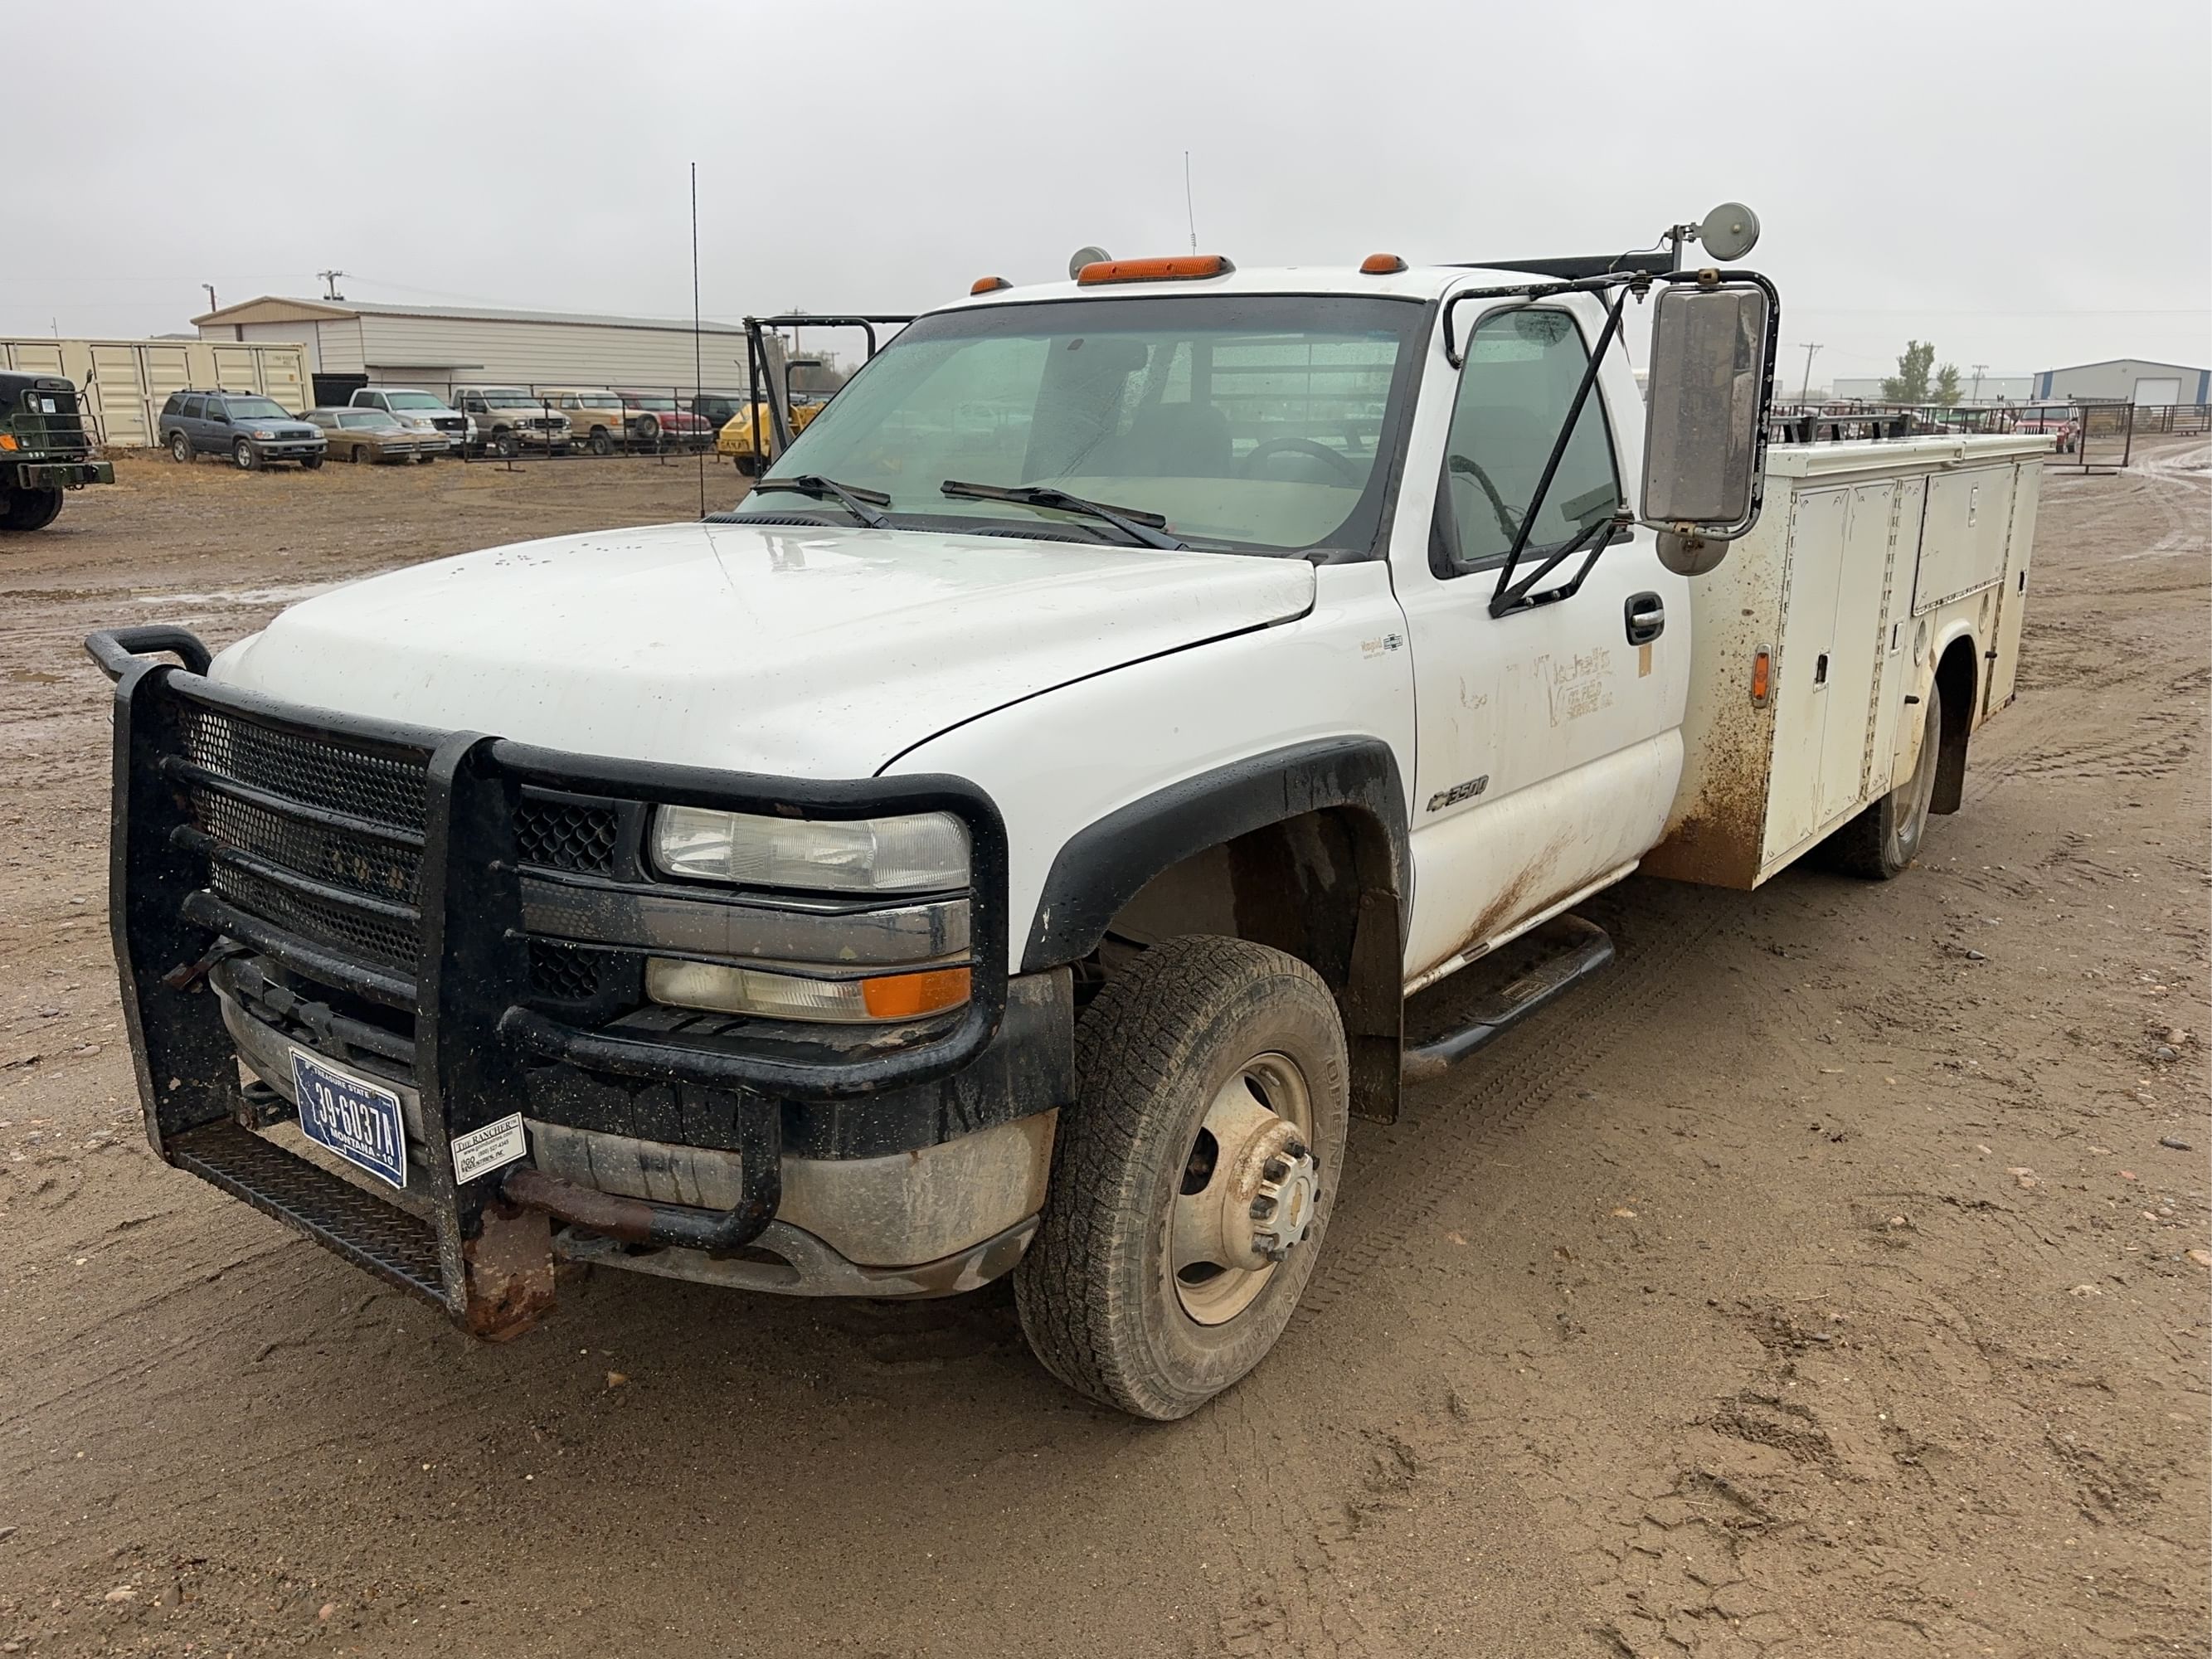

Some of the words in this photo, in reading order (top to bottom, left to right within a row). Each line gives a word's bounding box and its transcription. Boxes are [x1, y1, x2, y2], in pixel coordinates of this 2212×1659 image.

[1446, 774, 1489, 807] 3500
[313, 1067, 347, 1089] TREASURE
[348, 1084, 370, 1099] STATE
[1326, 1058, 1343, 1170] OPEN
[330, 1127, 376, 1156] MONTANA
